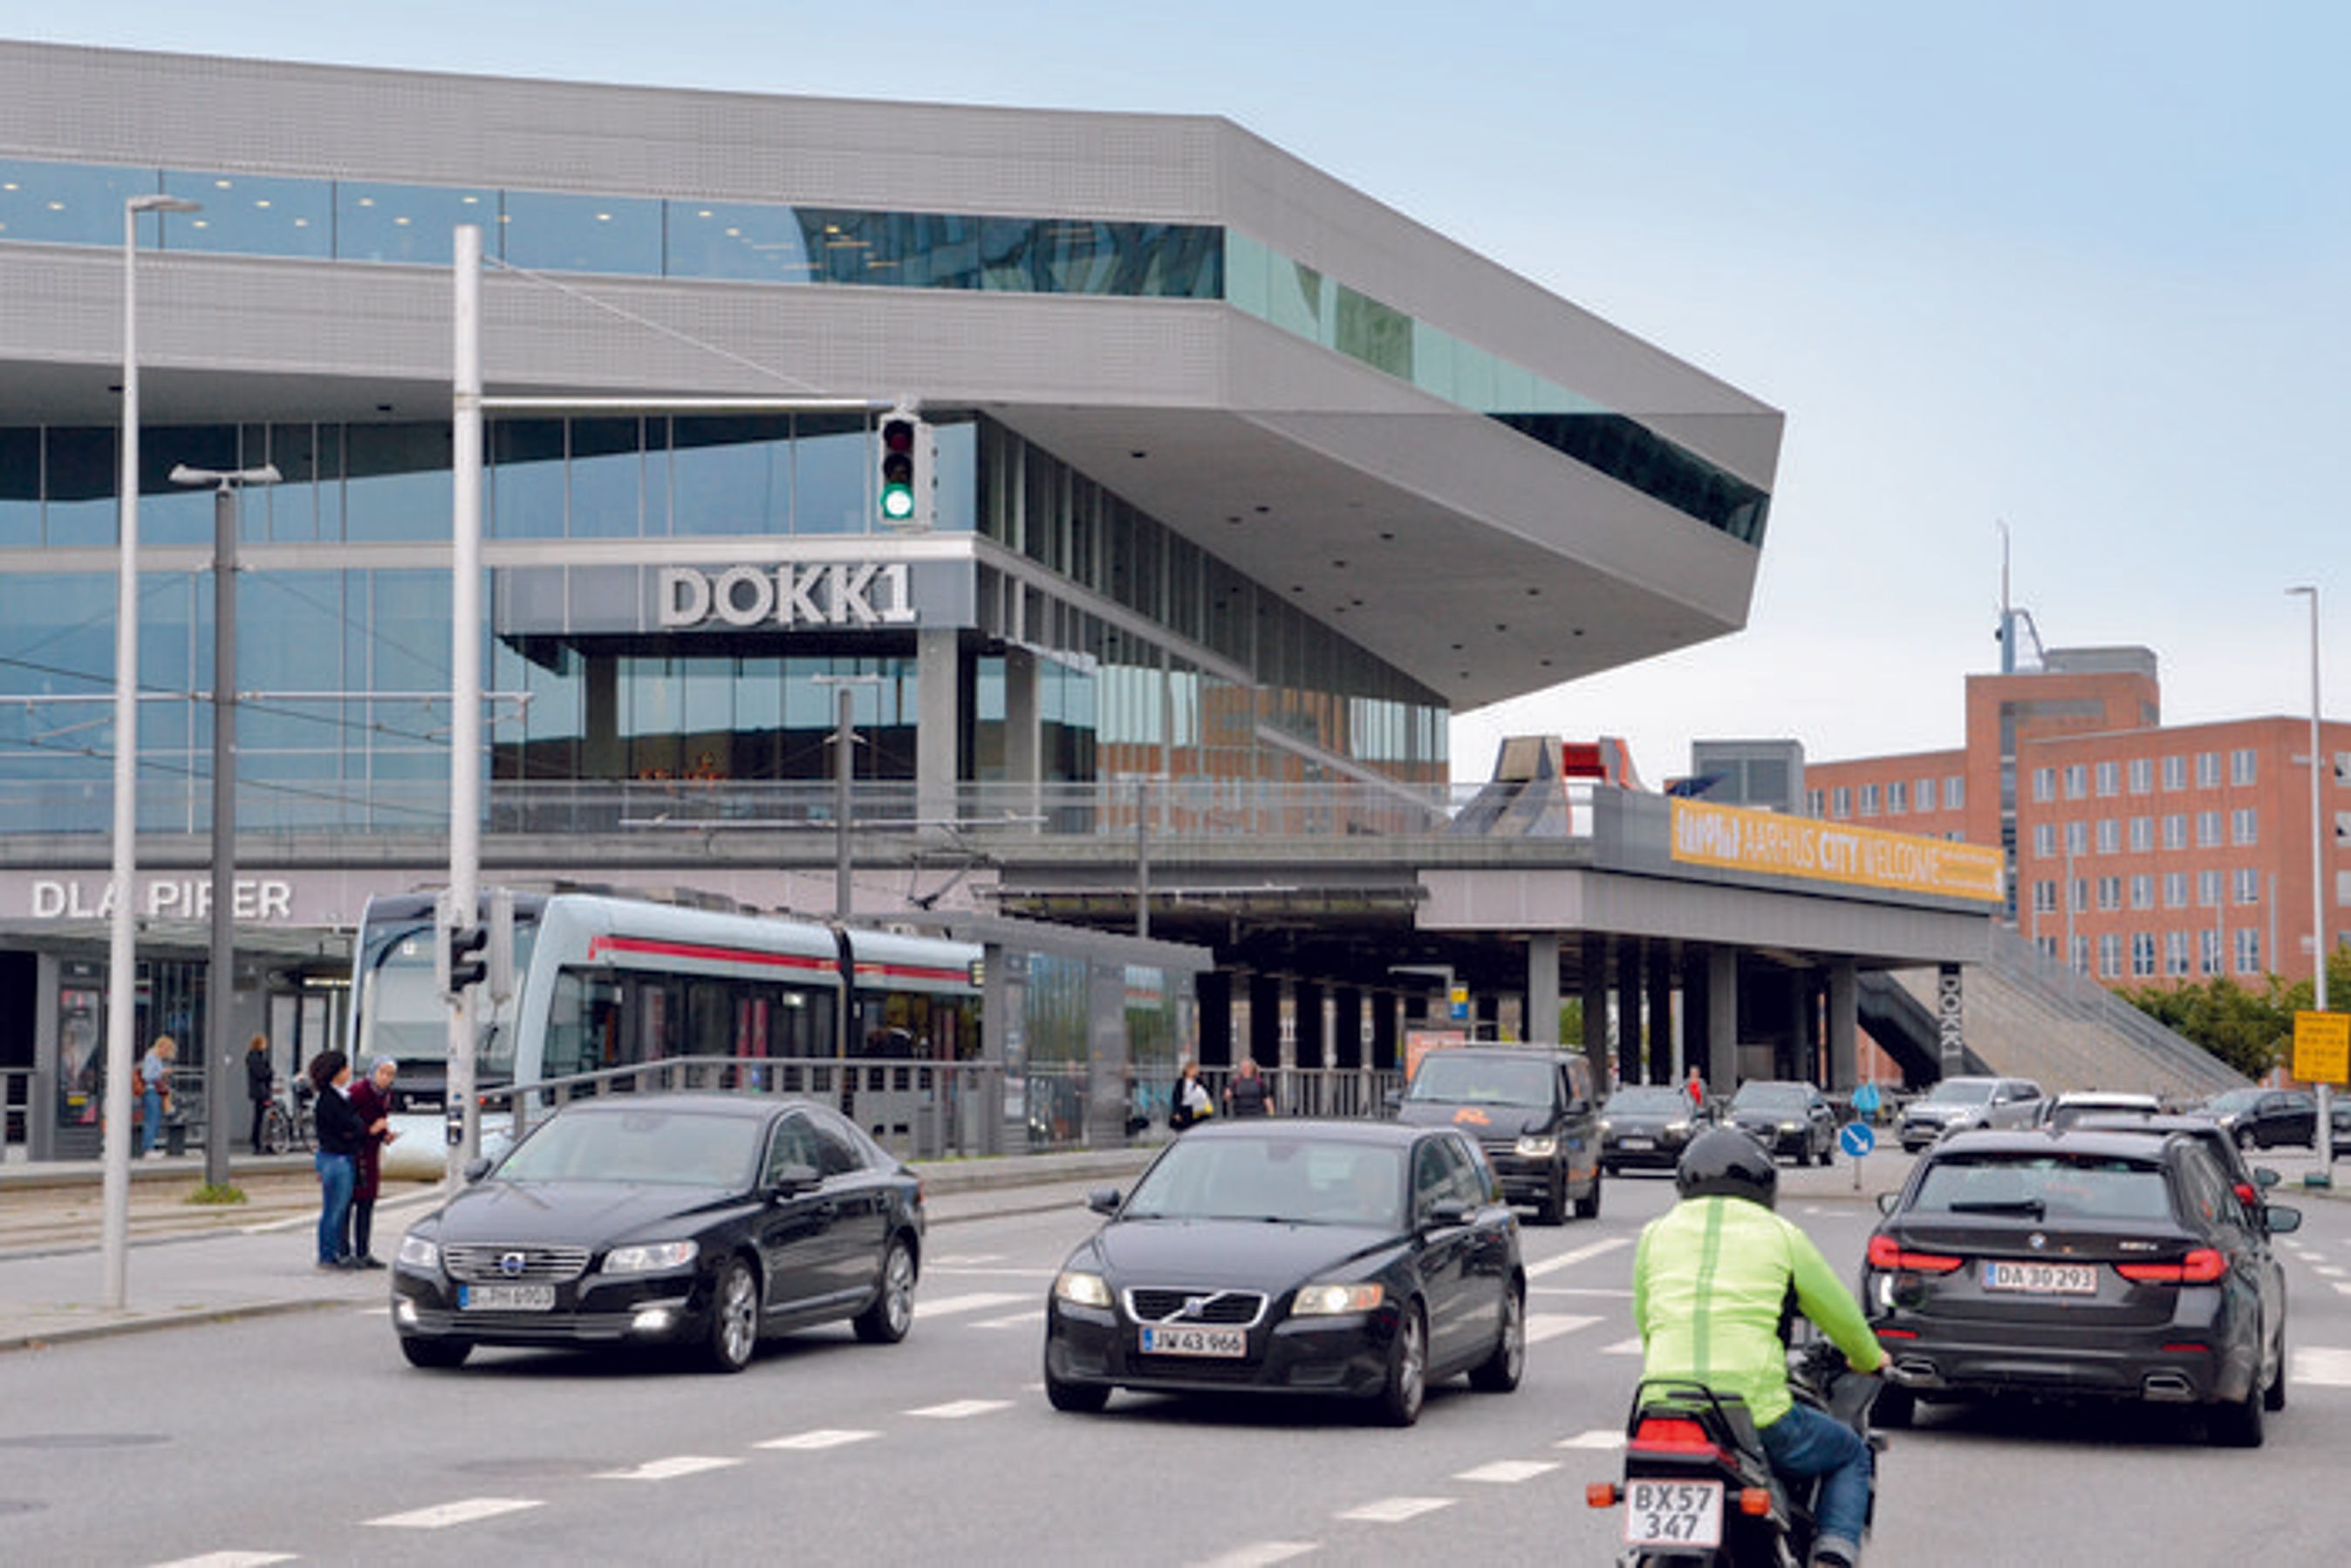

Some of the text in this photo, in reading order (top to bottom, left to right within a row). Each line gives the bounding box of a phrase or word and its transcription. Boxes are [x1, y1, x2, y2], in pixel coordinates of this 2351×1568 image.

[659, 563, 914, 626] DOKK1
[1744, 818, 1941, 886] AARHUS CITY WELCOME
[1998, 1266, 2023, 1284] DA
[2055, 1269, 2091, 1287] 293
[1207, 1333, 1240, 1353] 966
[1635, 1486, 1712, 1512] BX57
[1644, 1514, 1698, 1541] 347
